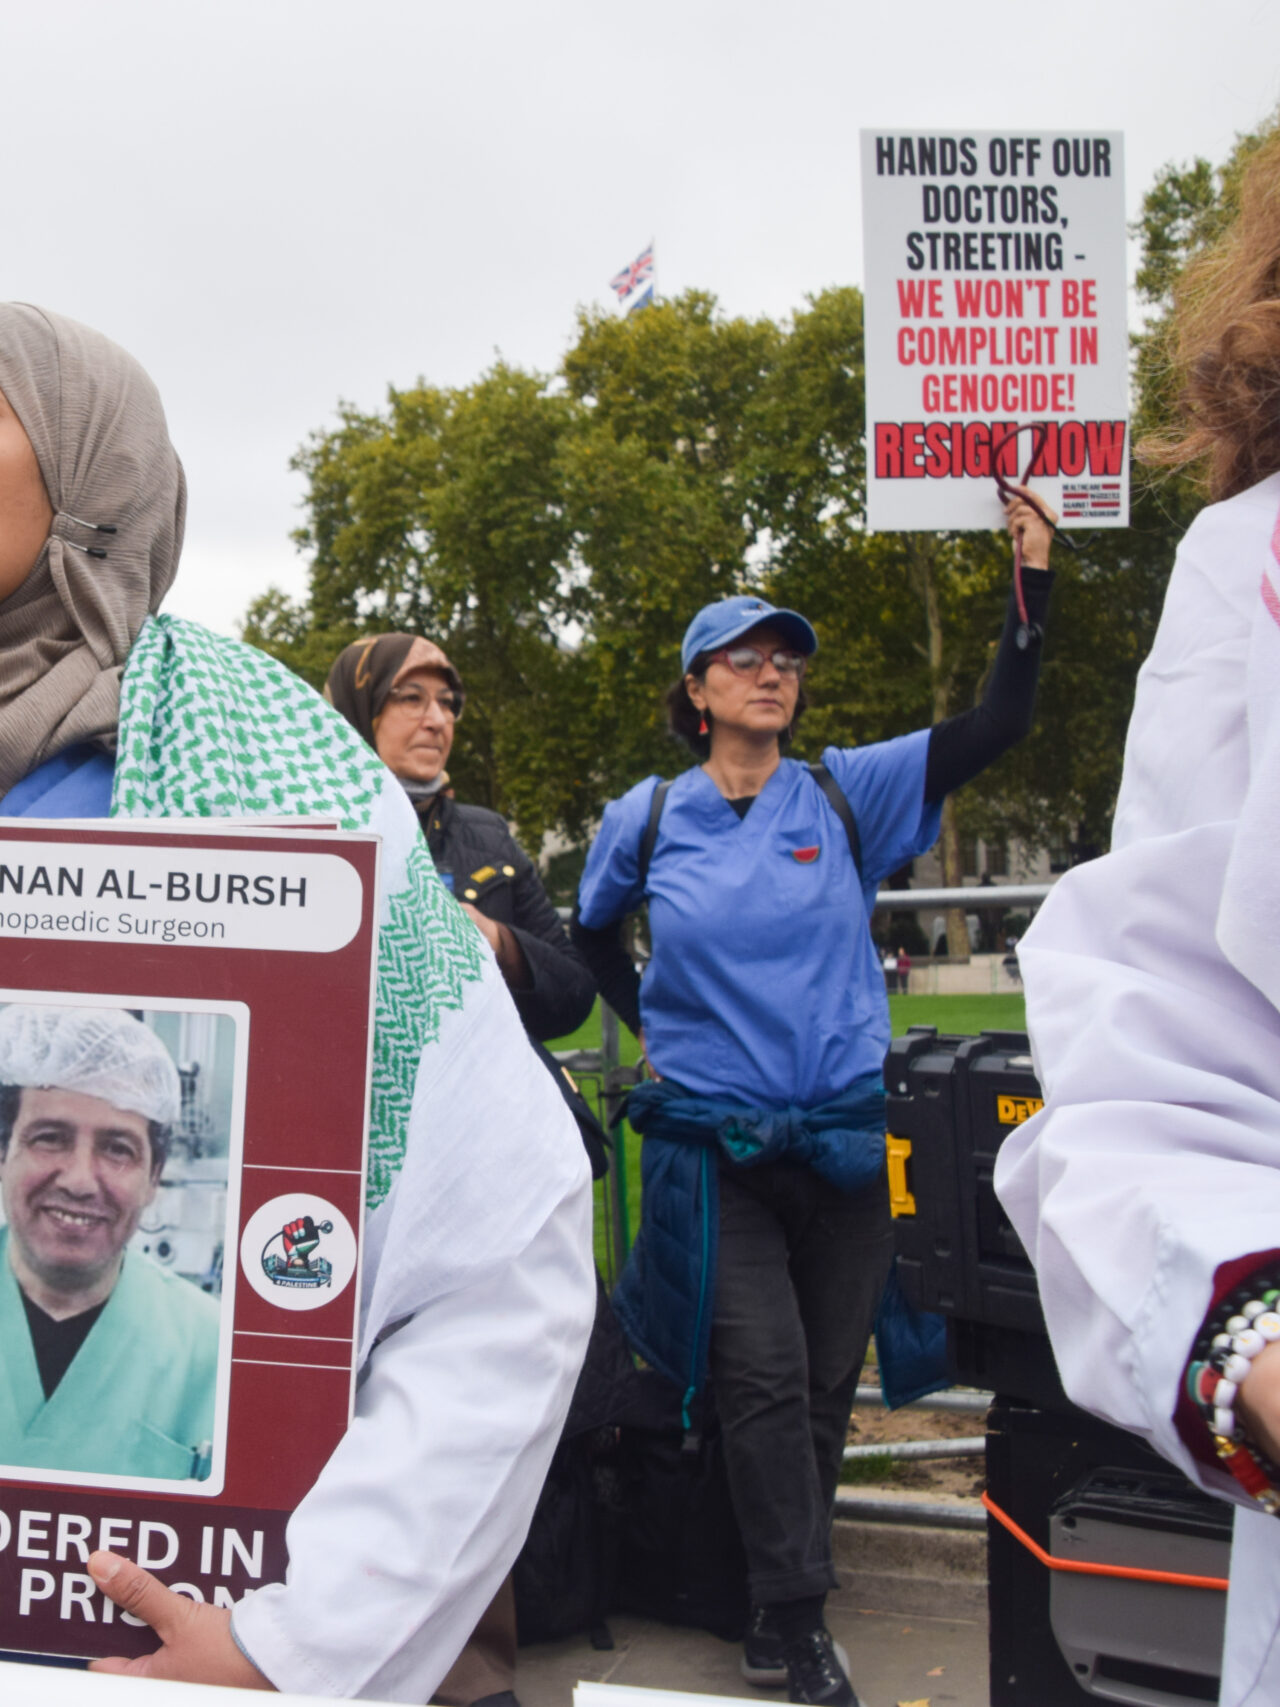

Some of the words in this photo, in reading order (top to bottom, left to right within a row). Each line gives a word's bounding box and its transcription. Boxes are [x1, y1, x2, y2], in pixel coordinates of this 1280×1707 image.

[876, 137, 978, 176] HANDS
[989, 138, 1041, 177] OFF
[1053, 138, 1111, 177] OUR
[923, 185, 1069, 229] DOCTORS,
[907, 232, 1063, 271] STREETING
[897, 280, 943, 318] WE
[955, 279, 1050, 318] WON'T
[1062, 280, 1098, 318] BE
[897, 326, 1059, 366] COMPLICIT
[1070, 327, 1099, 365] IN
[923, 374, 1075, 413] GENOCIDE!
[874, 421, 1019, 479] RESIGN
[1031, 420, 1127, 477] NOW
[97, 869, 309, 907] AL-BURSH
[117, 911, 225, 942] Surgeon
[200, 1526, 265, 1578] IN
